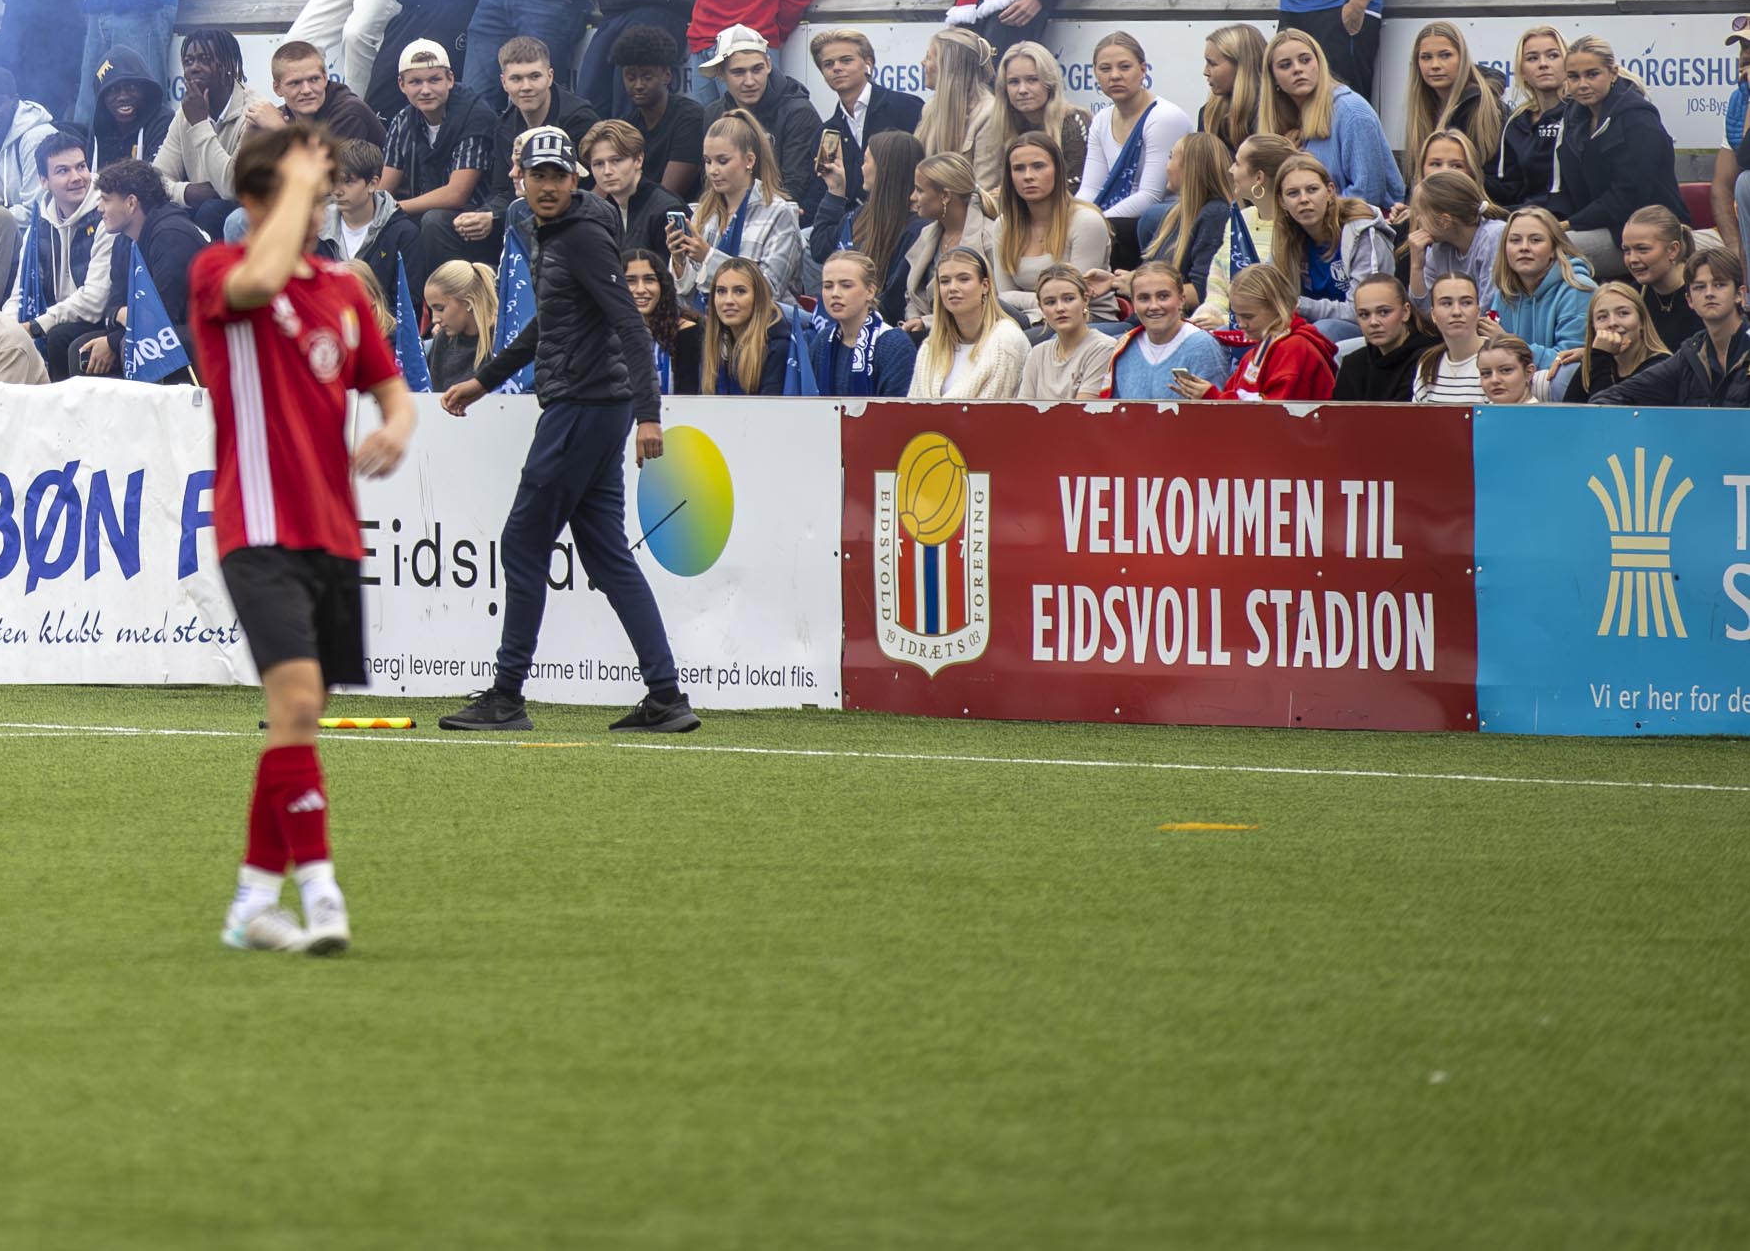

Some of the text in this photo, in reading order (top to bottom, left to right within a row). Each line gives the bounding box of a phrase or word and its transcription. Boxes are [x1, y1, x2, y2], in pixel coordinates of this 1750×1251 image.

[1620, 57, 1739, 88] ORGESHU
[1686, 97, 1728, 117] JOS-Byg
[1058, 475, 1404, 559] VELKOMMEN TIL
[880, 490, 891, 621] EIDSVOLD
[973, 490, 985, 623] FORENING
[39, 609, 103, 644] klubb
[116, 609, 169, 644] med
[172, 615, 240, 645] stort
[1031, 583, 1436, 672] EIDSVOLL STADION
[899, 637, 966, 660] IDRÆTS
[363, 653, 405, 681] nergi
[409, 654, 466, 677] leverer
[578, 659, 593, 681] til
[598, 660, 642, 683] bane
[677, 664, 712, 685] sert
[717, 661, 741, 692] på
[746, 664, 786, 687] lokal
[791, 665, 818, 688] flis.
[1589, 683, 1611, 709] Vi
[1618, 689, 1641, 710] er
[1648, 683, 1683, 711] her
[1690, 684, 1721, 712] for
